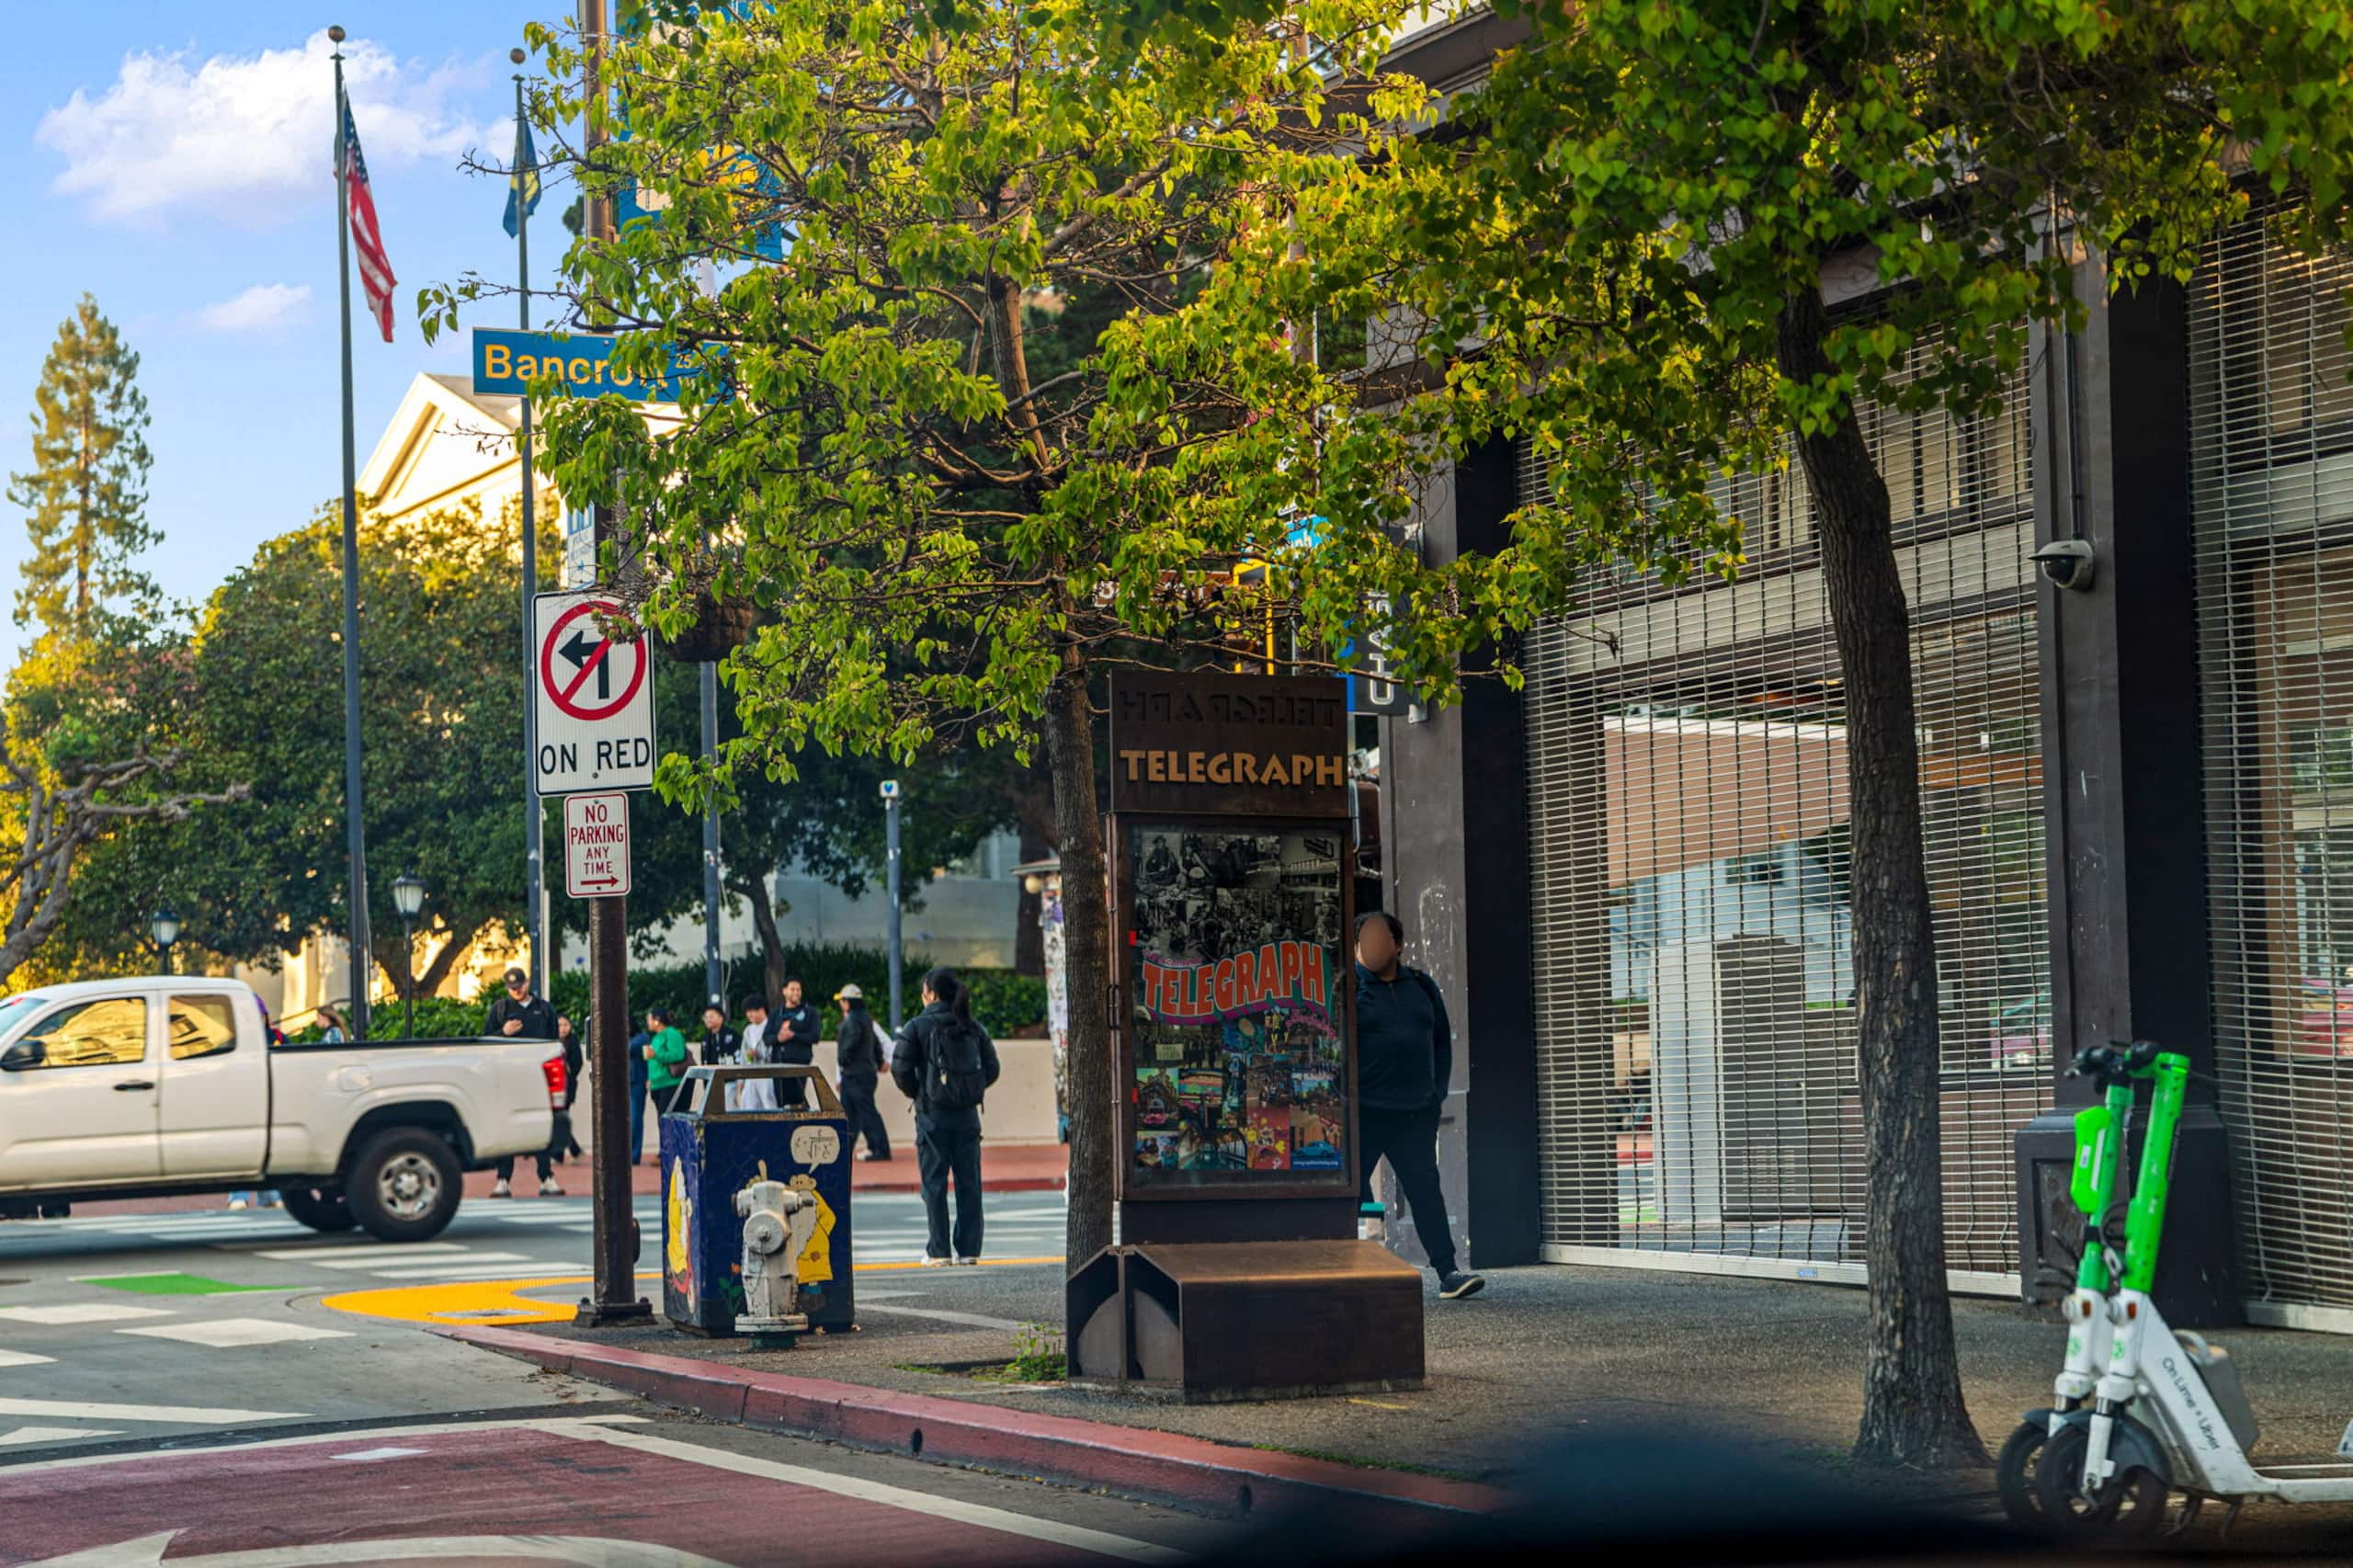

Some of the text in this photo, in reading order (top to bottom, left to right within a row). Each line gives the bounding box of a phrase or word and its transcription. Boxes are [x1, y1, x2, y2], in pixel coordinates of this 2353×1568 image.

[540, 738, 651, 774] ON RED
[1120, 749, 1344, 787] TELEGRAPH
[585, 805, 608, 823] NO
[571, 825, 624, 845] PARKING
[586, 847, 609, 859] ANY
[584, 862, 613, 874] TIME
[1142, 941, 1325, 1017] TELEGRAPH
[2163, 1358, 2177, 1375] On
